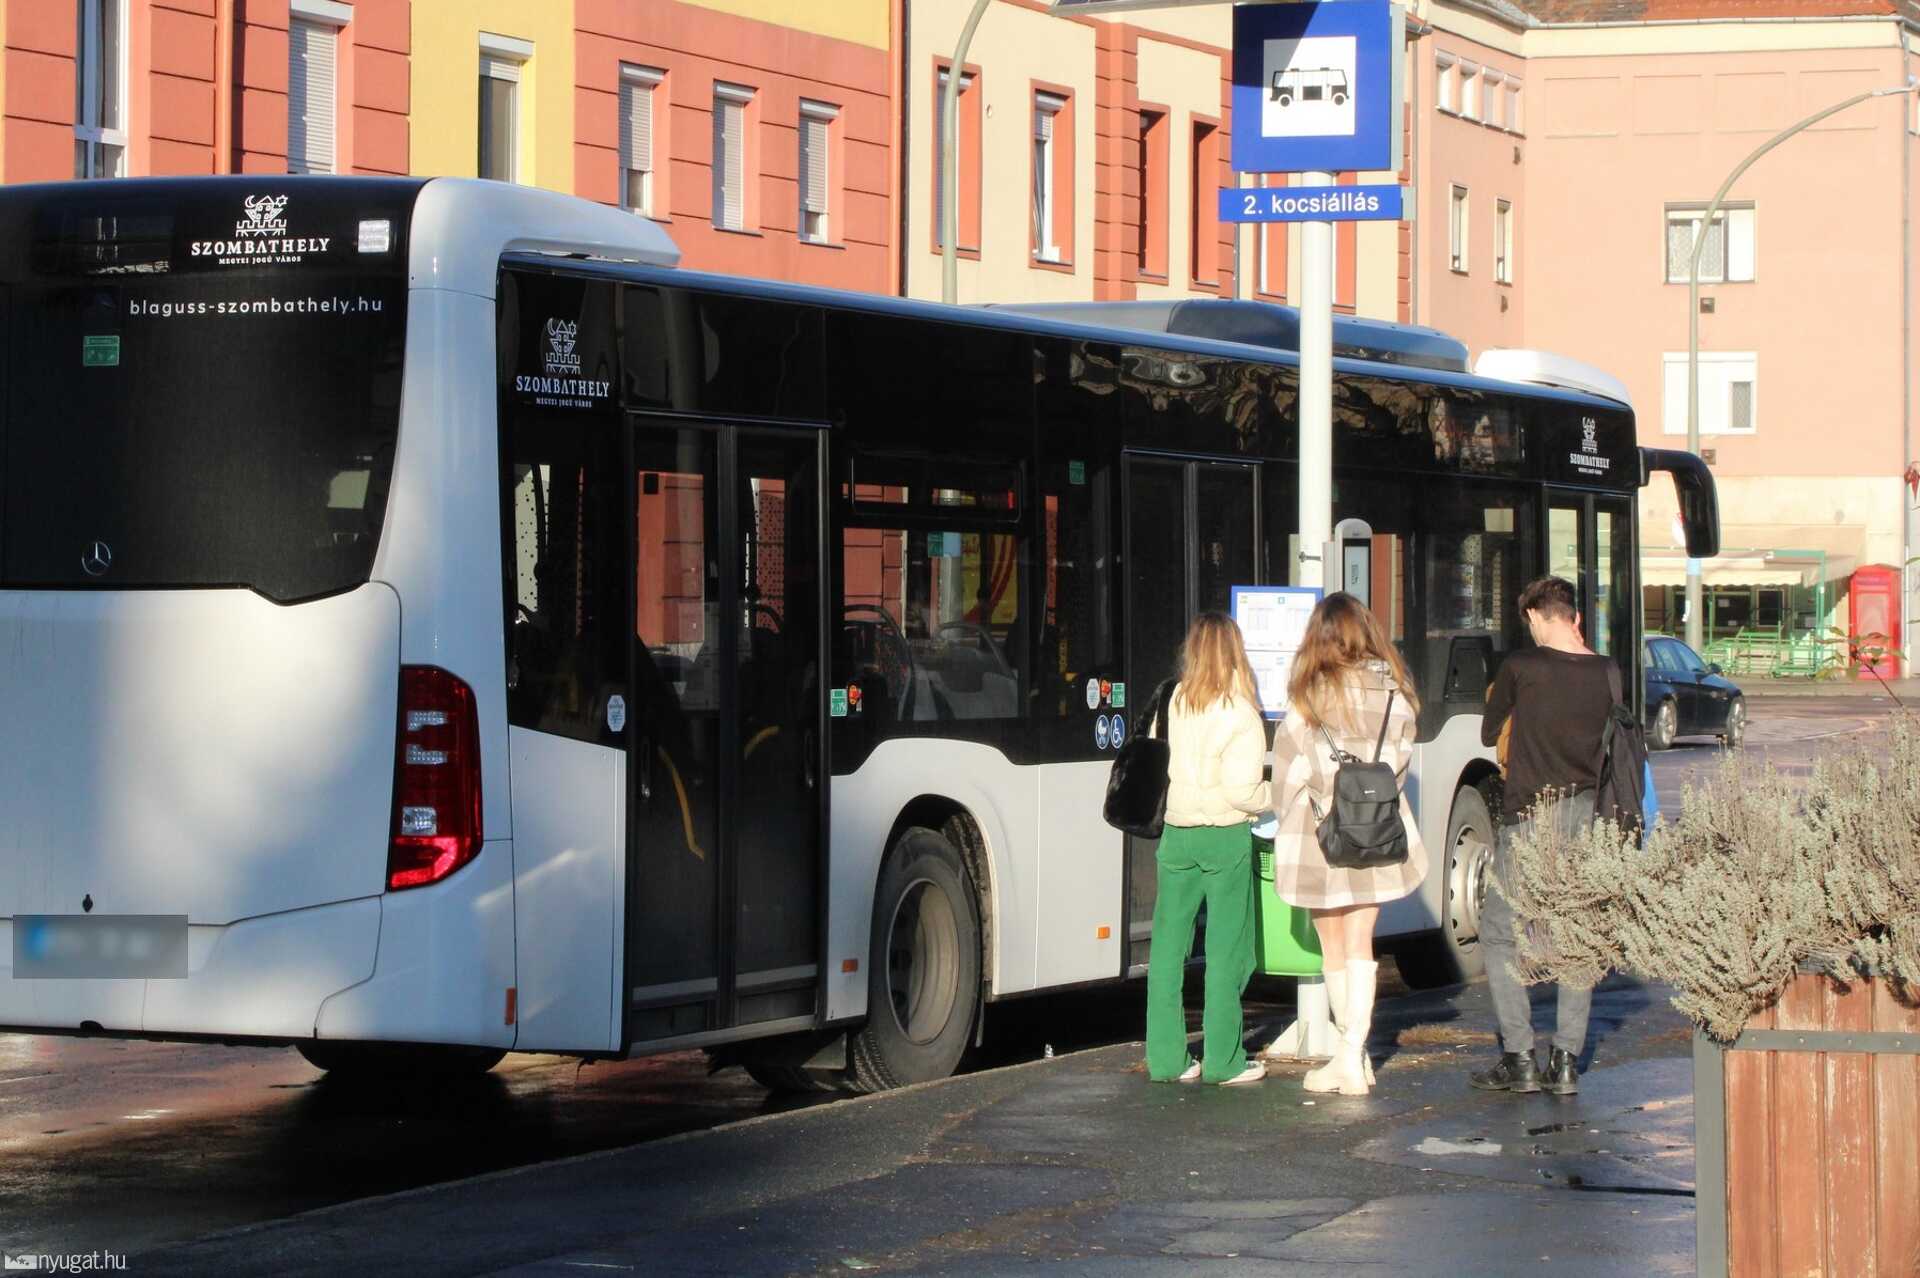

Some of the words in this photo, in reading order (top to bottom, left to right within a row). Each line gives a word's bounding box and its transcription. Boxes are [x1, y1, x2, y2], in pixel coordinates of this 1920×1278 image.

[1243, 195, 1263, 215] 2.
[1272, 192, 1380, 214] kocsiállás
[191, 238, 330, 256] SZOMBATHELY
[219, 257, 249, 265] MEGYEI
[275, 255, 302, 263] VÁROS
[130, 297, 383, 317] blaguss-szombathely.hu
[516, 375, 609, 397] SZOMBATHELY
